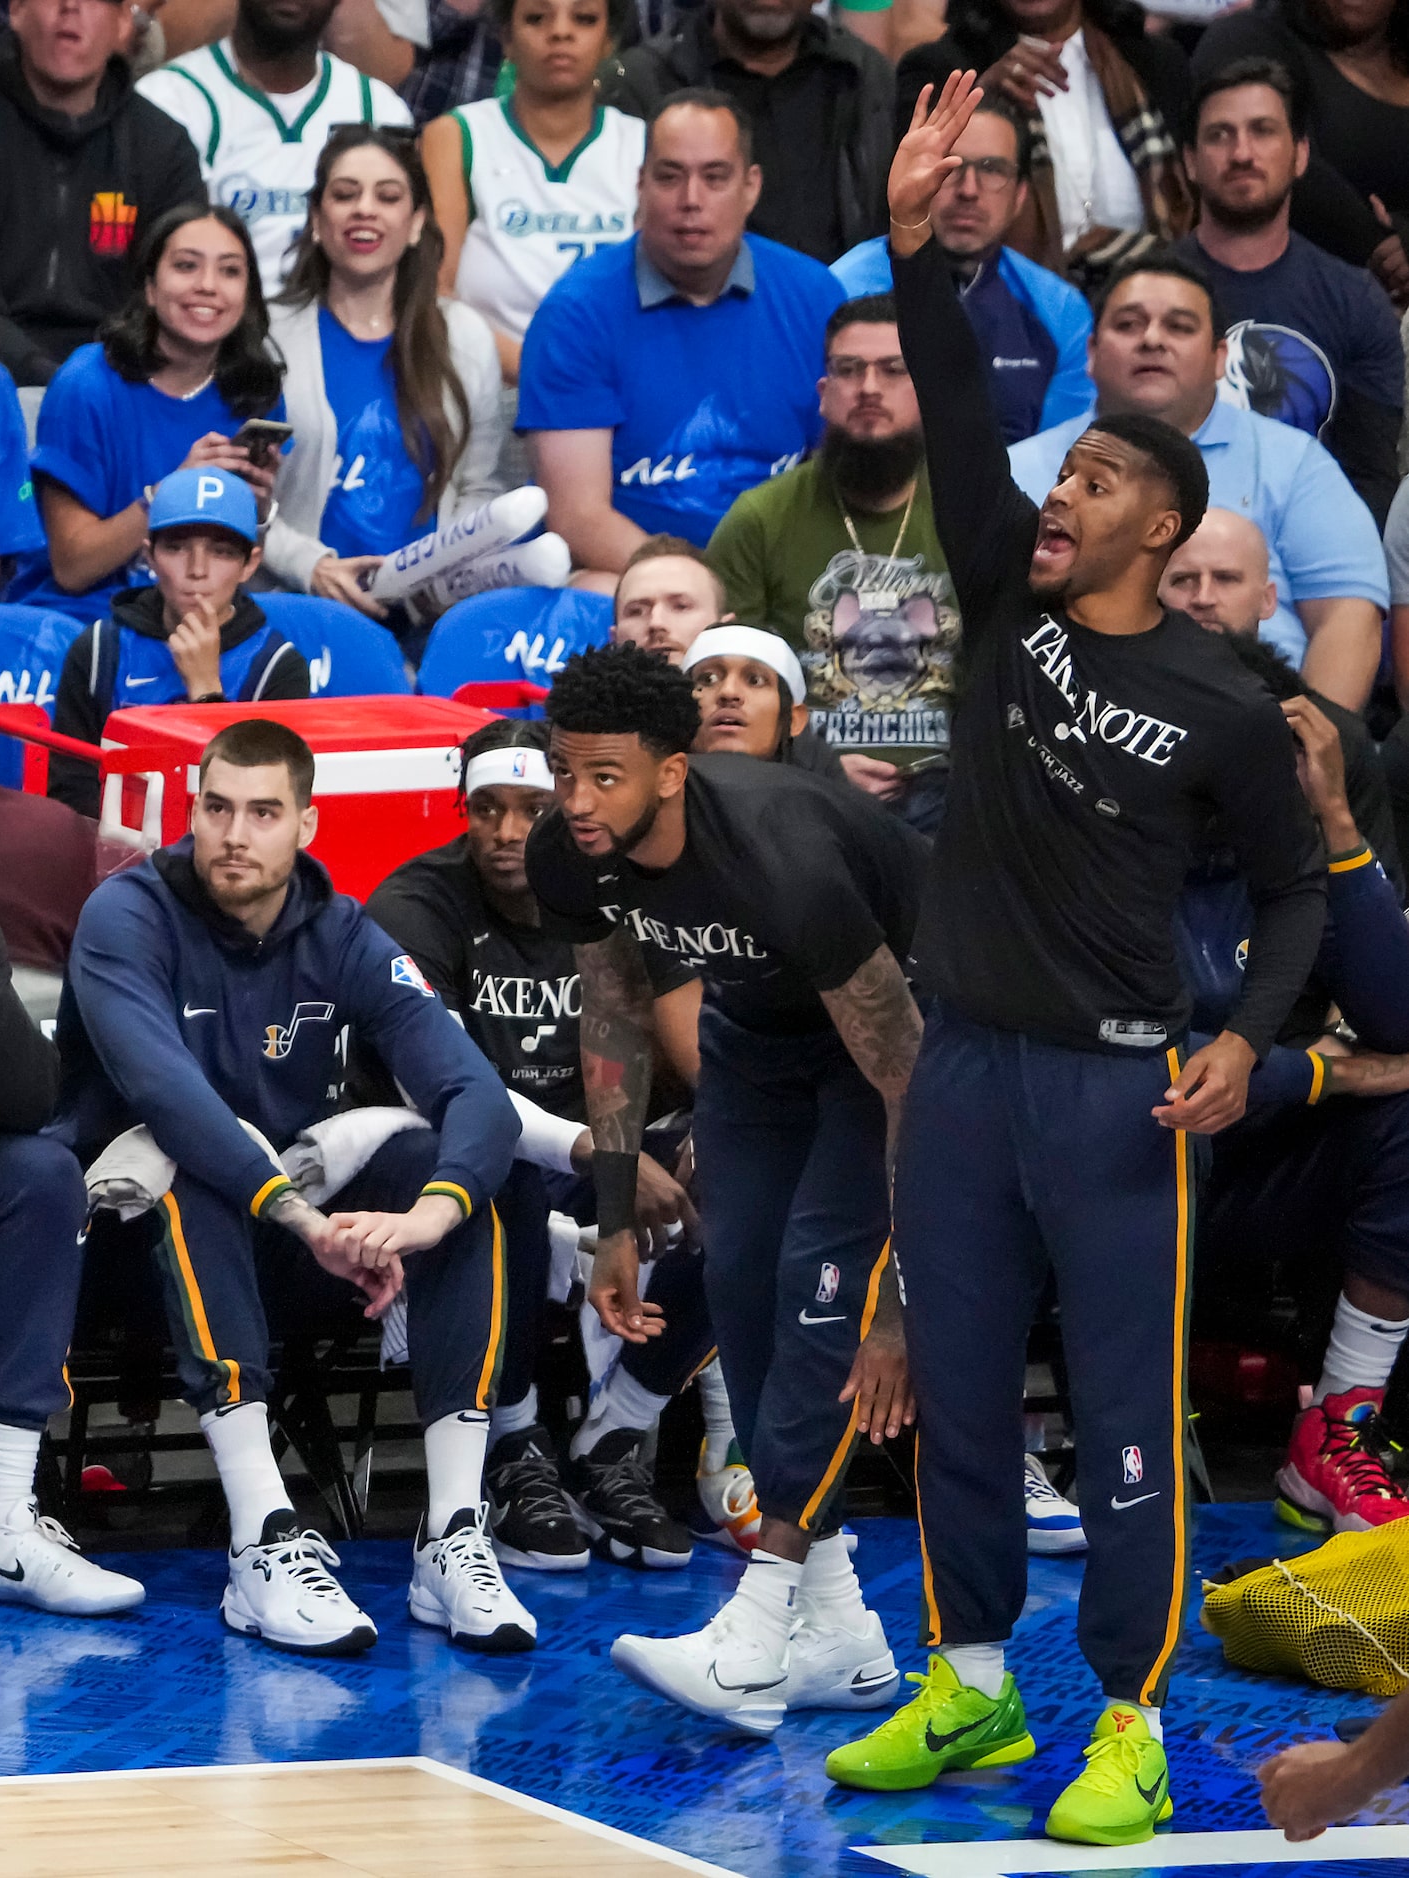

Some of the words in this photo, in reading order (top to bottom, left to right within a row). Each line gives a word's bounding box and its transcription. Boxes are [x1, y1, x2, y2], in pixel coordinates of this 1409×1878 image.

[620, 453, 697, 485] ALL
[196, 475, 225, 509] P
[504, 629, 565, 676] ALL
[1075, 690, 1188, 767] NOTE
[511, 1067, 539, 1079] UTAH
[542, 1065, 576, 1079] JAZZ
